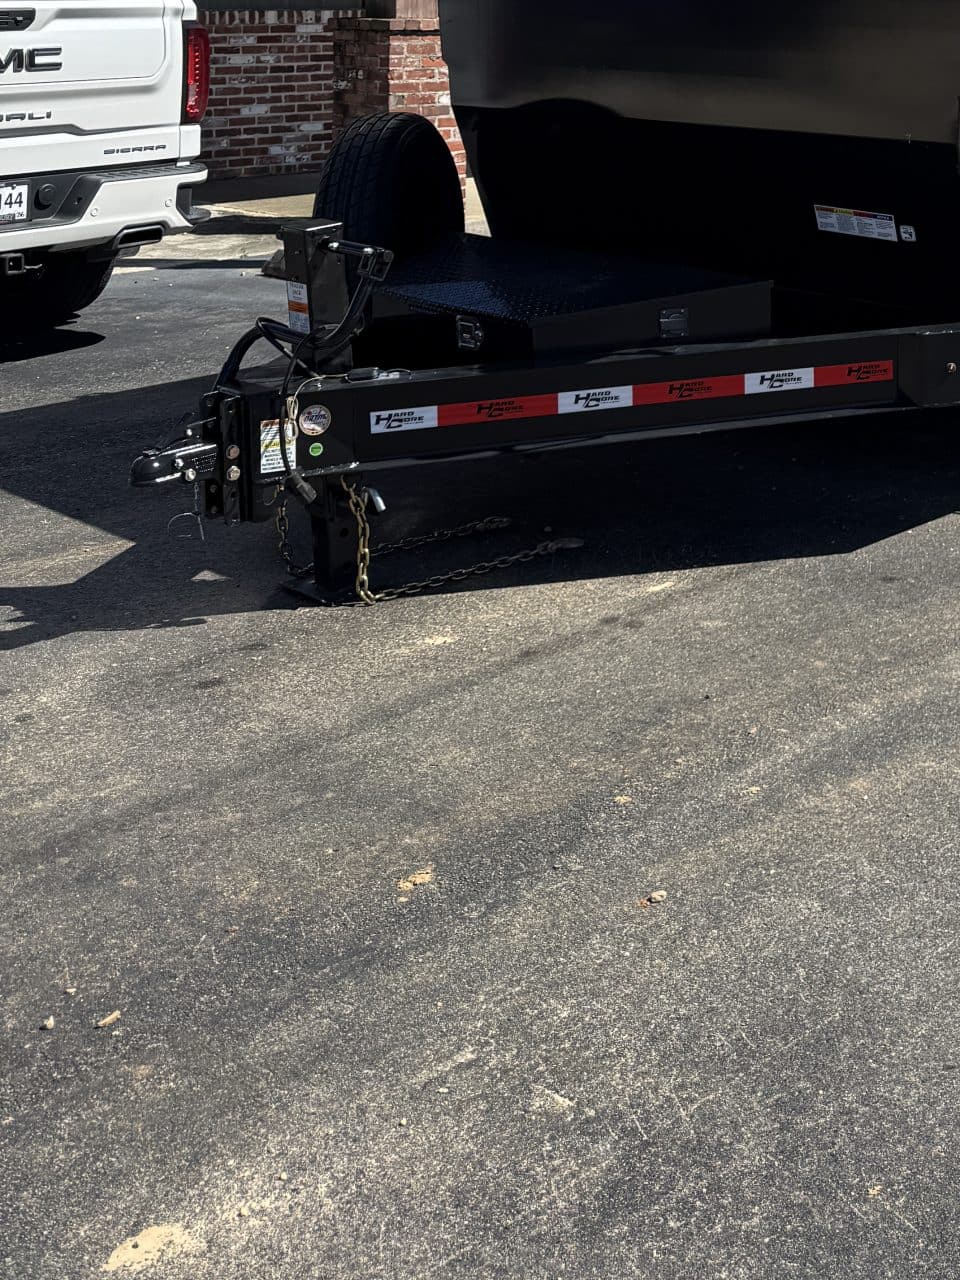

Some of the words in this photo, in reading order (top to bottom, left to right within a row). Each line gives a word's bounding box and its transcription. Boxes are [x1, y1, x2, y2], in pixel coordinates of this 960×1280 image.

[103, 144, 166, 155] SIERRA
[0, 191, 24, 209] 44
[760, 372, 794, 385] HARD
[574, 391, 611, 404] HARD
[375, 411, 415, 426] HARD
[386, 416, 424, 429] CORE
